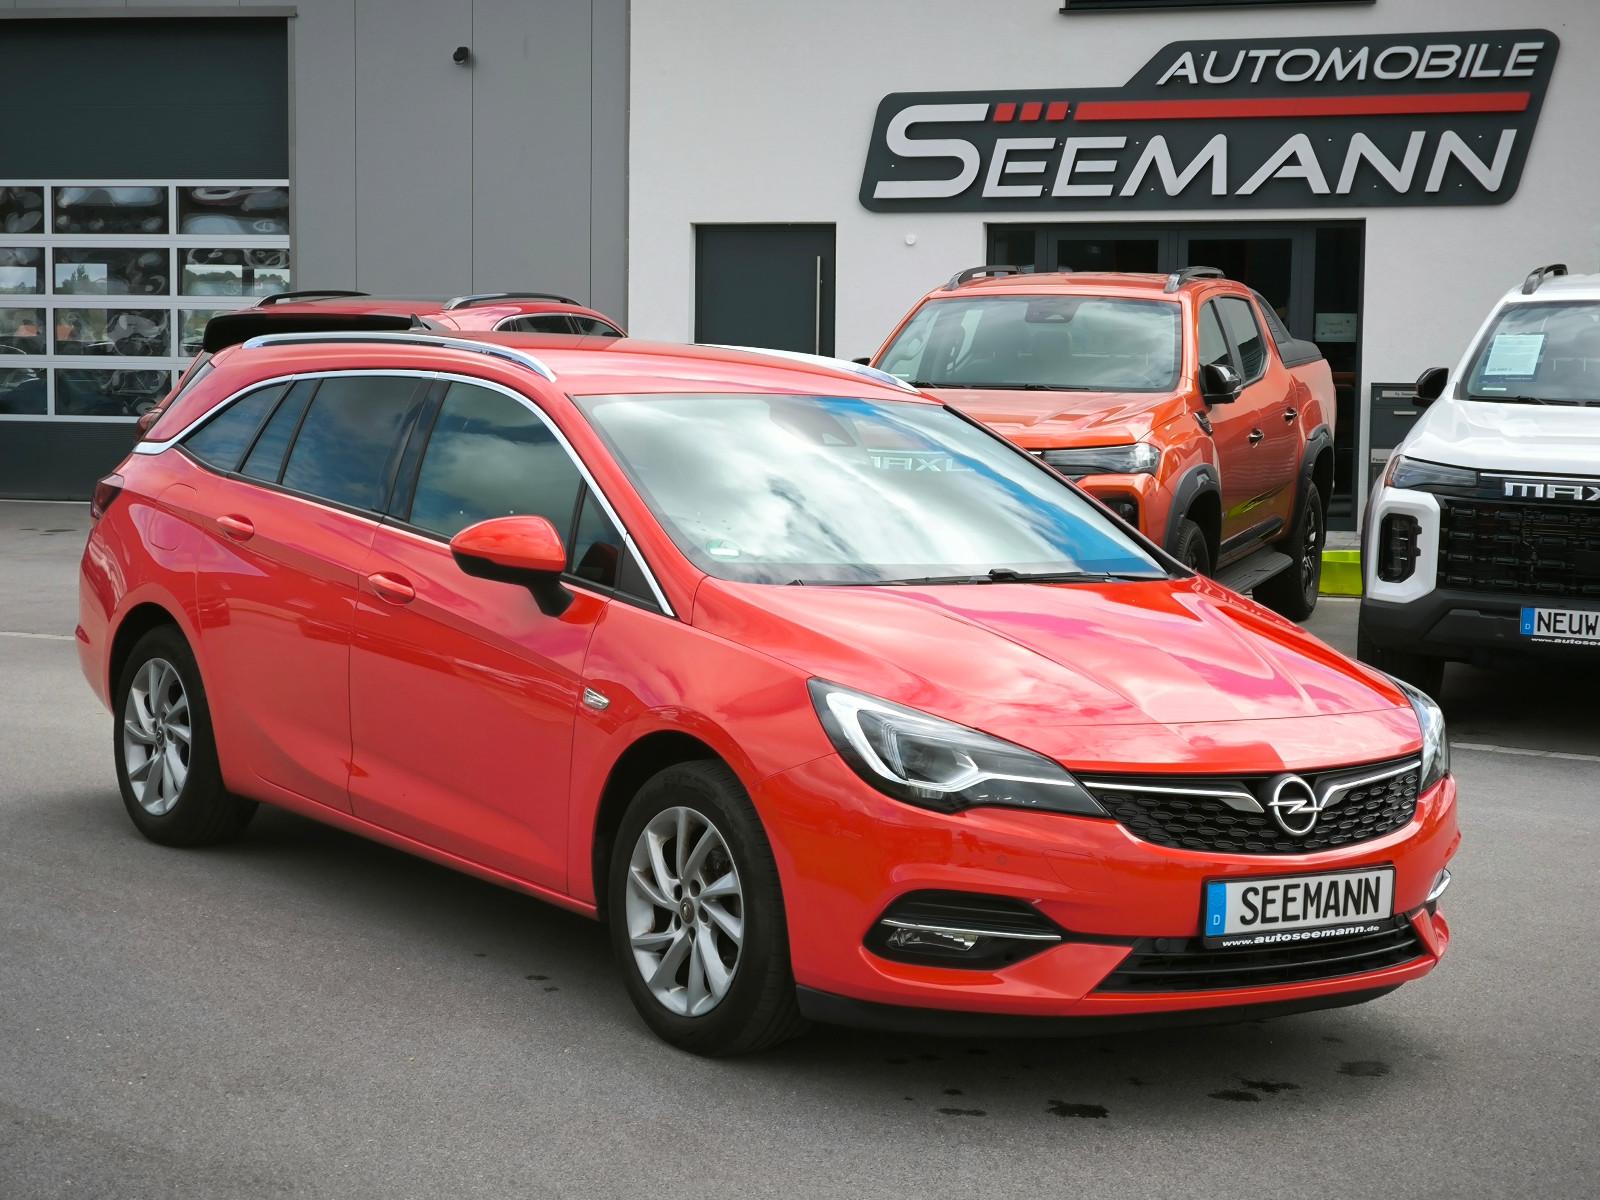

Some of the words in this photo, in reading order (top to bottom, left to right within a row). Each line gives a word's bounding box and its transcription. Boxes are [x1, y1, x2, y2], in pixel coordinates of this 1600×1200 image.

[1156, 42, 1544, 86] AUTOMOBILE
[873, 103, 1517, 198] SEEMANN
[1537, 611, 1599, 636] NEUW
[1240, 876, 1381, 926] SEEMANN
[1212, 914, 1221, 926] D
[1222, 925, 1380, 947] www.autoseemann.de
